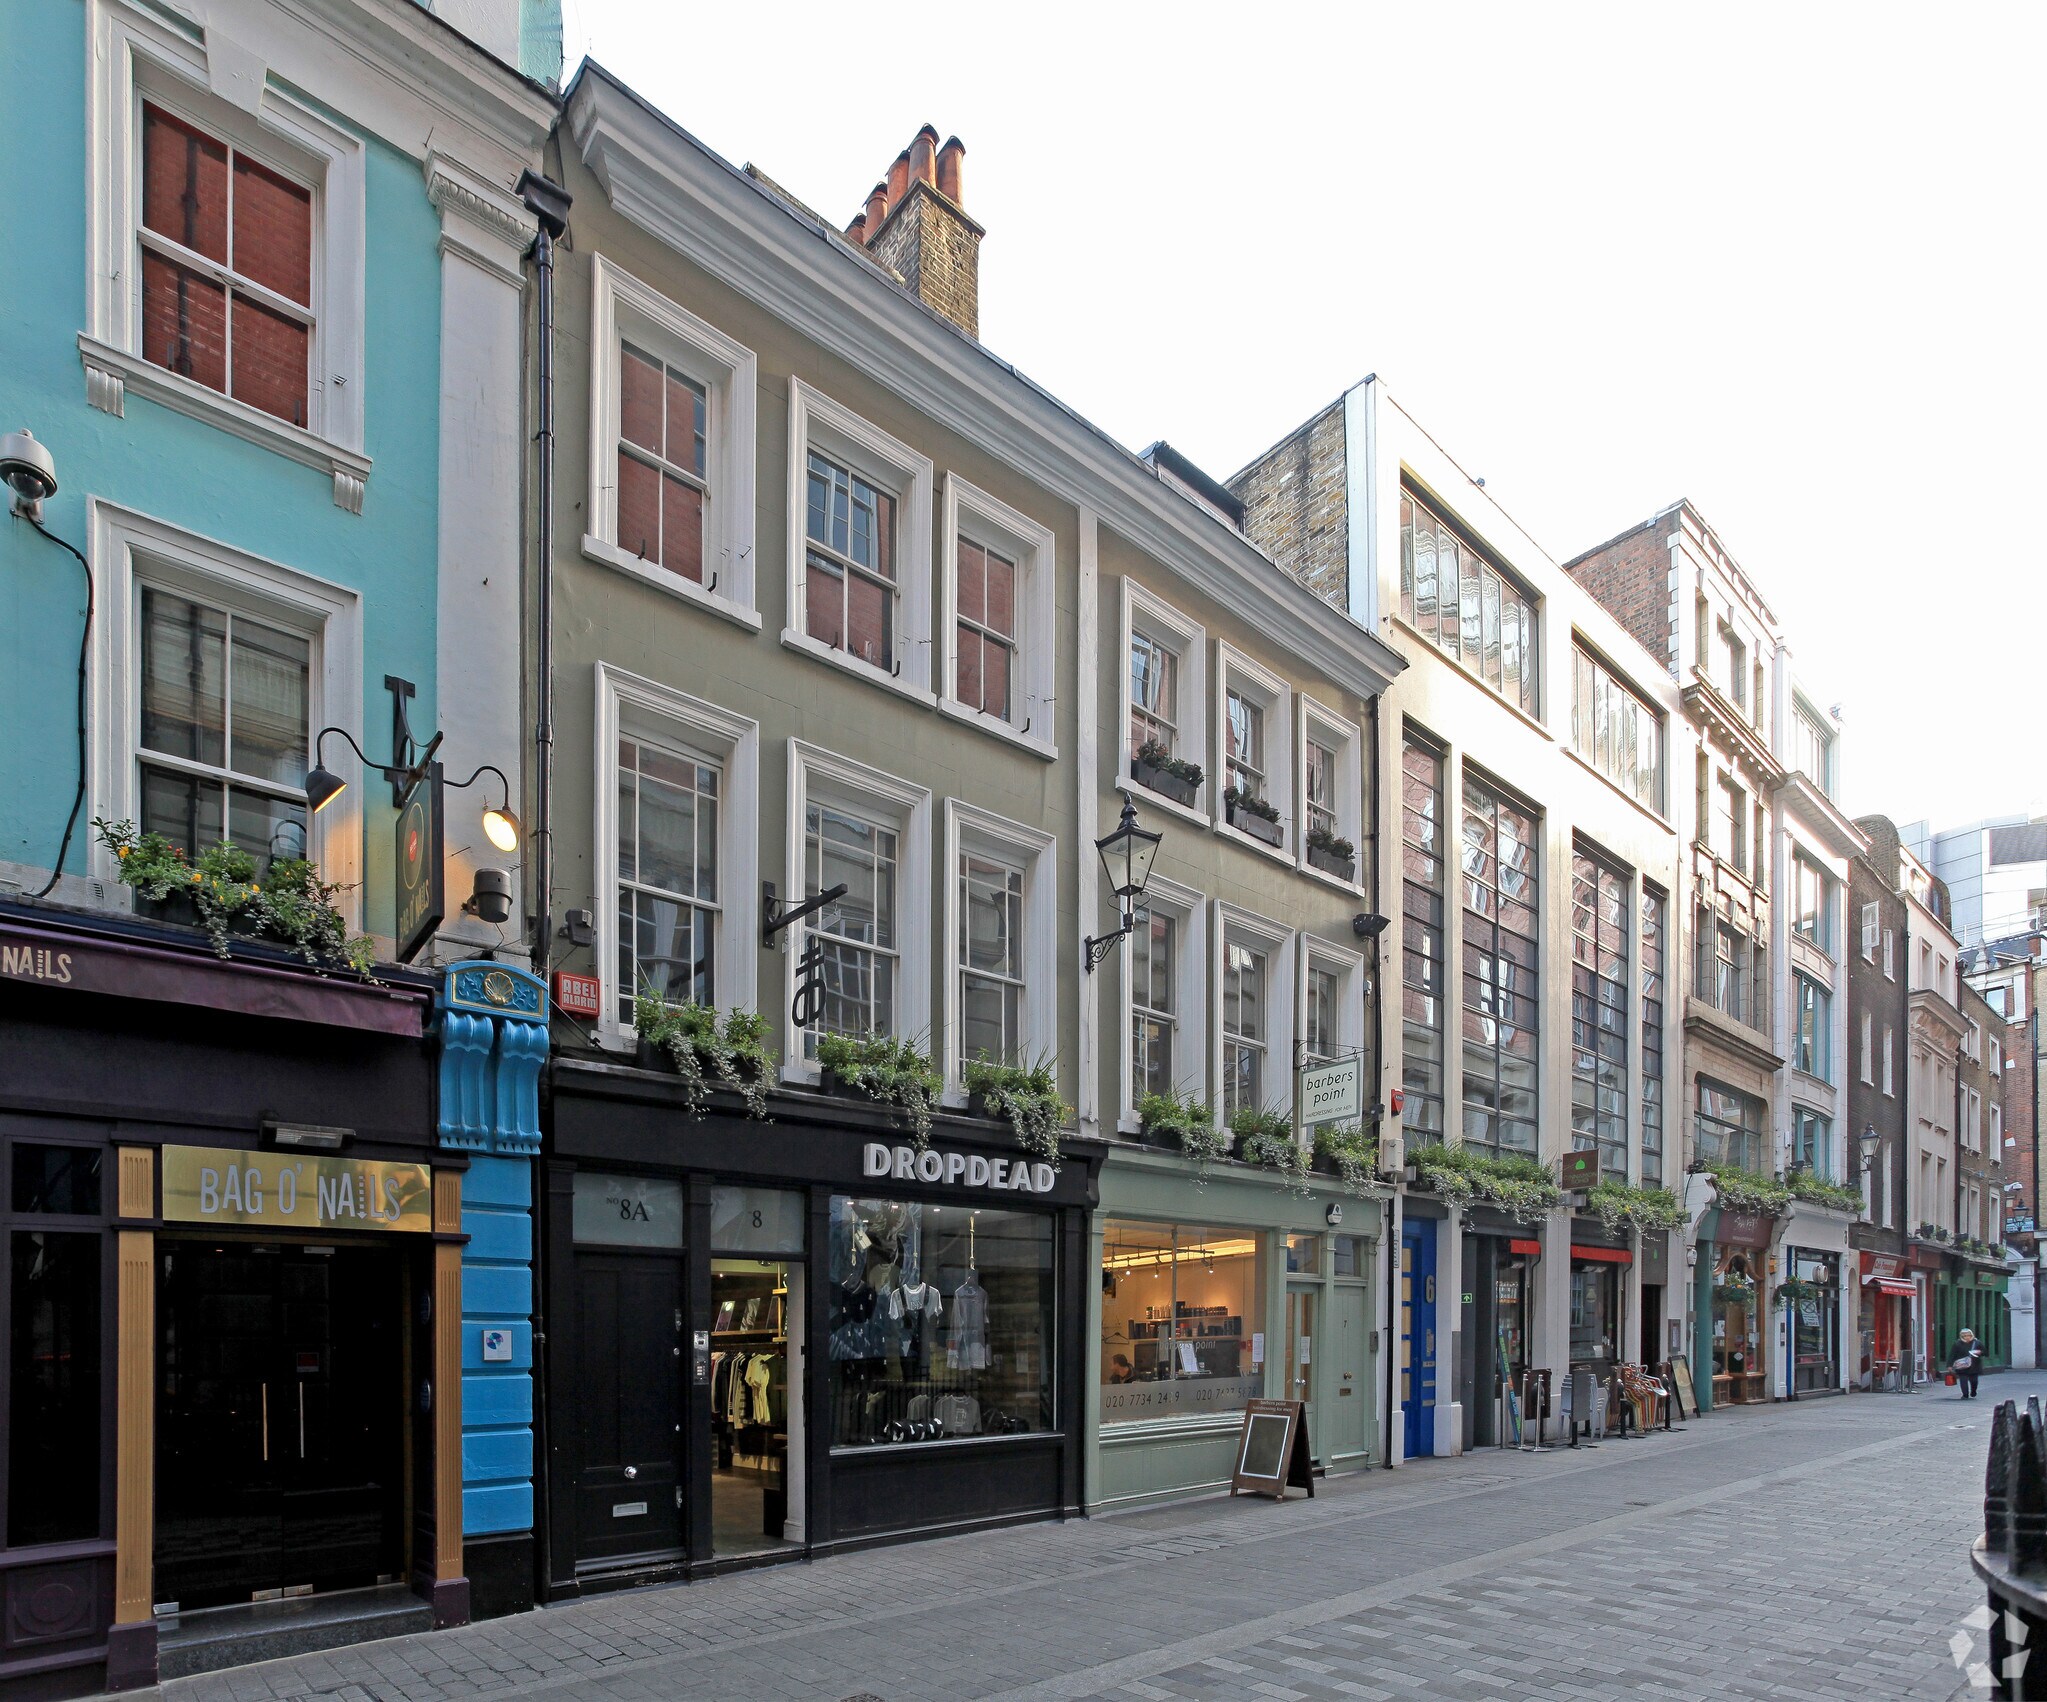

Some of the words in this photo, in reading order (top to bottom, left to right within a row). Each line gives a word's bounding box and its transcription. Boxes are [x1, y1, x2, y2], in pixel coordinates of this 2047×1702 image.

[2, 945, 72, 983] NAILS
[563, 979, 597, 998] ABEL
[563, 993, 597, 1009] ALARM
[1306, 1071, 1353, 1091] barbers
[1313, 1087, 1346, 1107] point
[863, 1142, 1056, 1193] DROPDEAD
[200, 1164, 264, 1215] BAG
[278, 1161, 304, 1215] O'
[318, 1172, 401, 1222] NAILS
[620, 1199, 650, 1222] 8A
[752, 1209, 763, 1229] 8
[1425, 1274, 1436, 1304] 6
[1343, 1319, 1348, 1328] 7
[1195, 1339, 1217, 1353] point
[1105, 1395, 1125, 1408] 020
[1129, 1393, 1152, 1406] 7734
[1157, 1391, 1180, 1404] 249
[1196, 1388, 1212, 1401] 020
